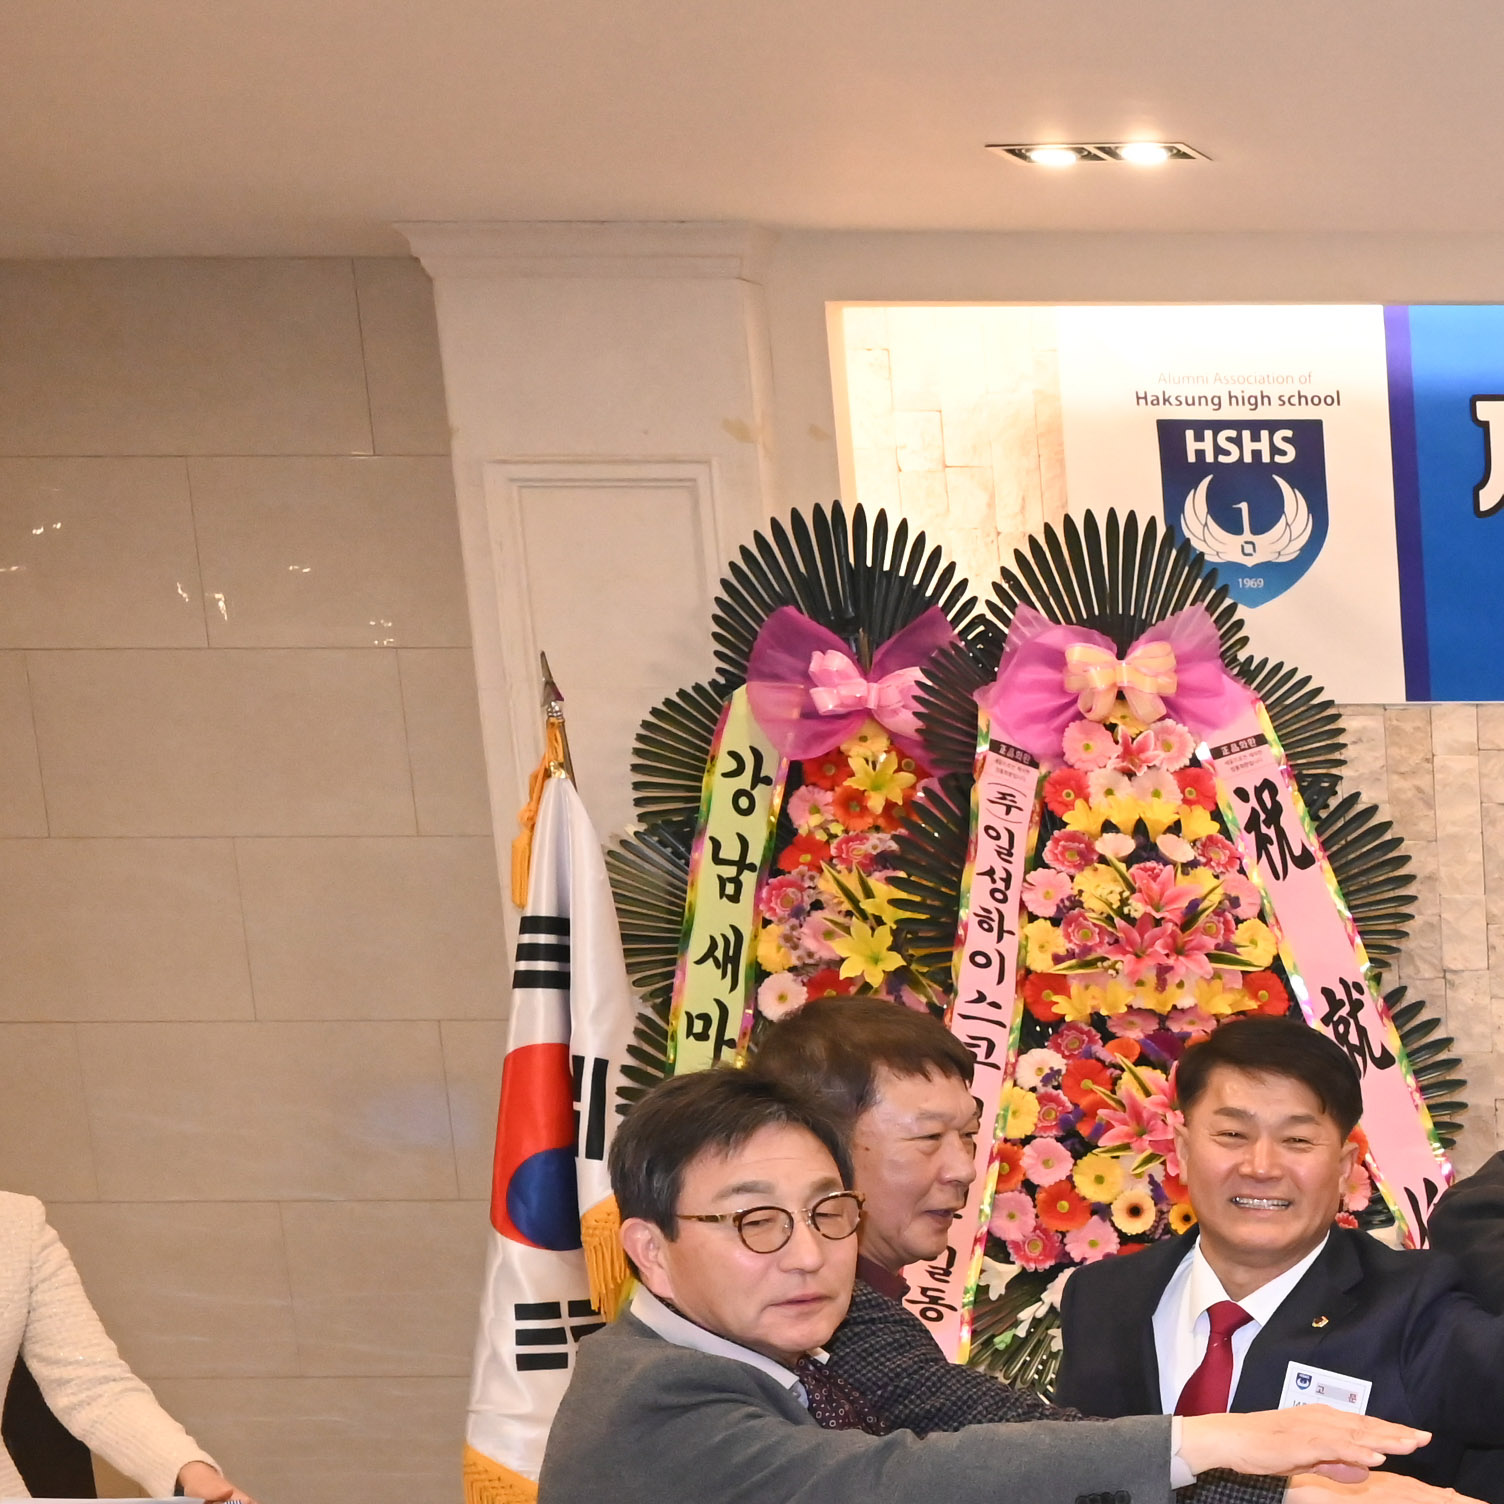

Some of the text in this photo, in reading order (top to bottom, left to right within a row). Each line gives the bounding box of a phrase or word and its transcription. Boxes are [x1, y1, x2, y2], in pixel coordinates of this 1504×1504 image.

[1158, 371, 1313, 385] Alumni Association of
[1135, 390, 1341, 411] Haksung high school
[1185, 429, 1296, 464] HSHS
[1238, 577, 1264, 589] 1969
